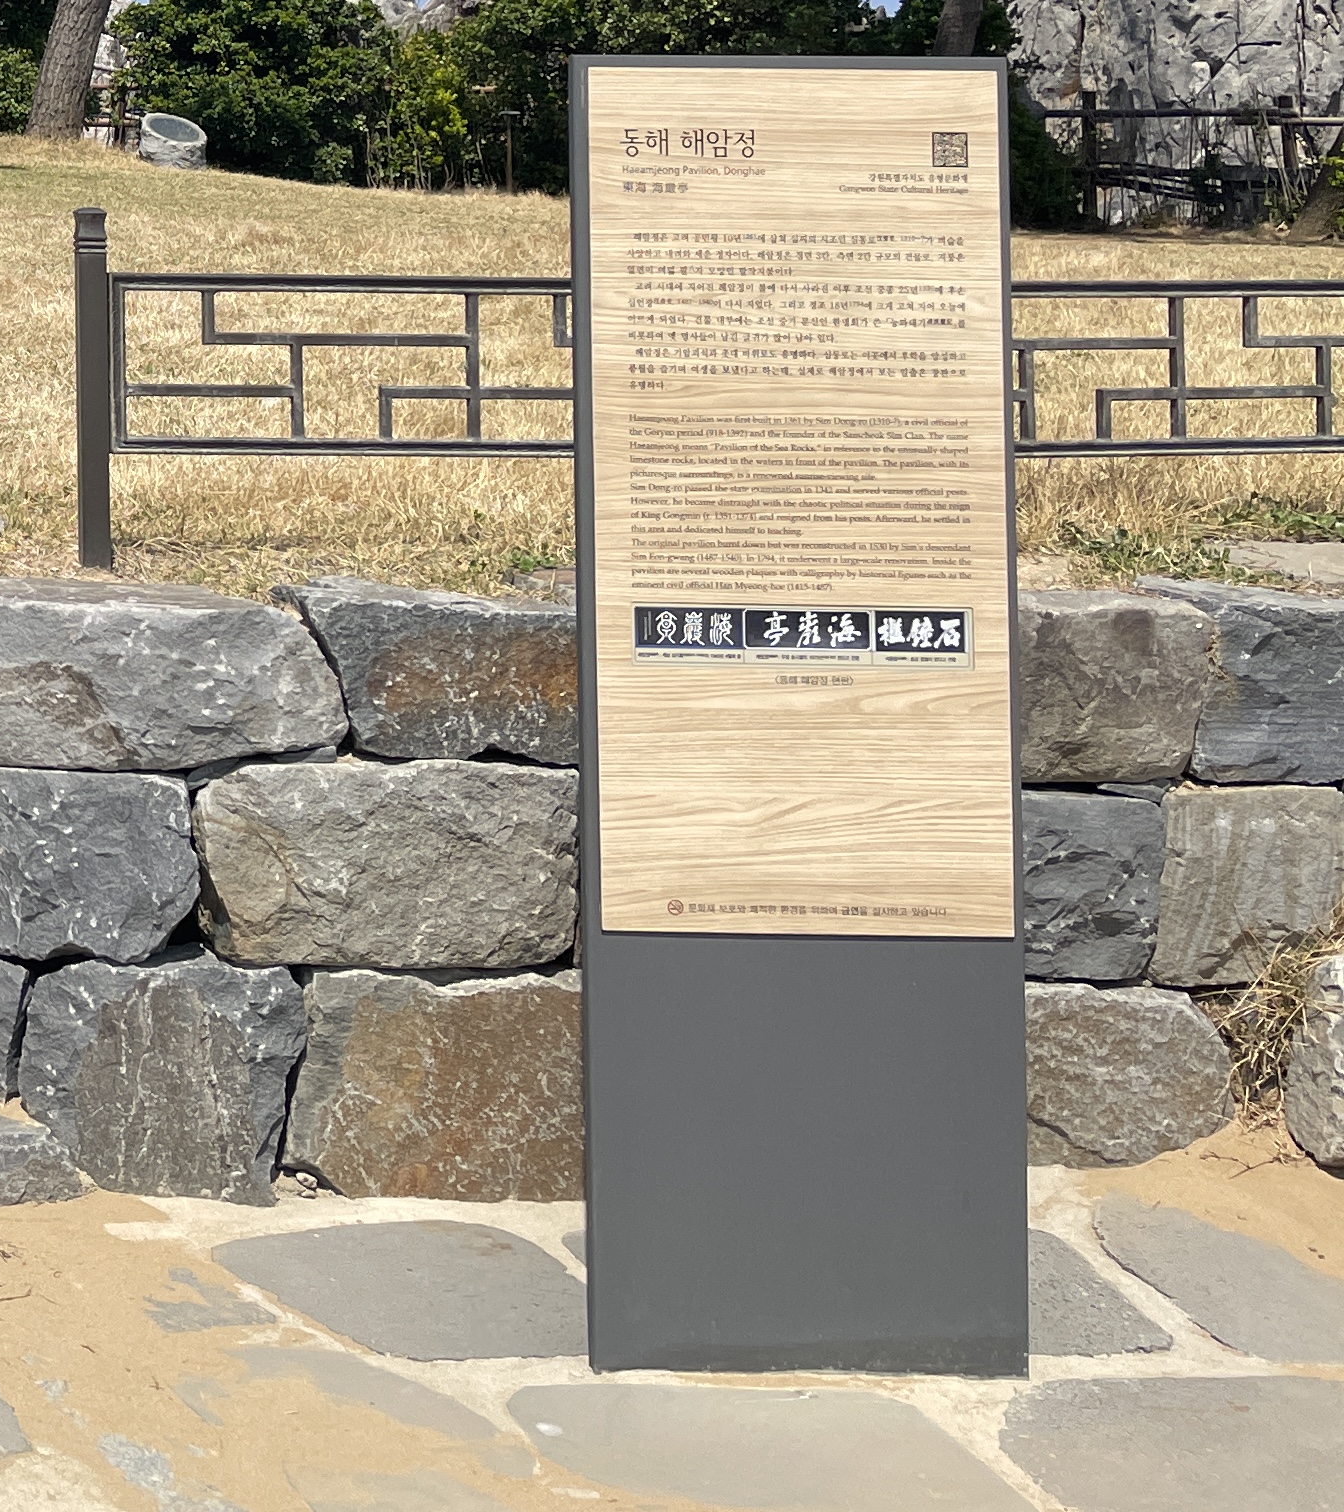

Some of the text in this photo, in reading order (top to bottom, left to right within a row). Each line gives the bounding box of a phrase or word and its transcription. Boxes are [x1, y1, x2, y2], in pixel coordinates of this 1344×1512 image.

[620, 129, 755, 158] 동해 해암정
[622, 165, 766, 177] Haeamjeong Pavilion, Donghae
[869, 173, 925, 182] 강원특별자치도
[623, 182, 646, 193] 東海
[839, 185, 876, 194] Gangwon
[935, 186, 969, 195] Heritage
[804, 416, 812, 425] by
[630, 428, 642, 436] the
[644, 428, 674, 438] Goryeo
[677, 429, 703, 438] period
[750, 429, 765, 437] and
[672, 456, 695, 465] rocks,
[630, 470, 676, 480] picturesque
[648, 483, 682, 493] Dong-ro
[715, 484, 728, 492] the
[804, 485, 812, 493] in
[673, 498, 683, 506] he
[641, 512, 660, 521] King
[663, 512, 701, 521] Gongmin
[649, 539, 680, 548] original
[682, 540, 715, 549] pavilion
[889, 543, 899, 551] by
[632, 568, 665, 577] pavilion
[681, 568, 710, 576] several
[712, 568, 744, 576] wooden
[746, 569, 777, 578] plaques
[799, 570, 844, 578] calligraphy
[847, 570, 856, 578] by
[686, 582, 713, 590] official
